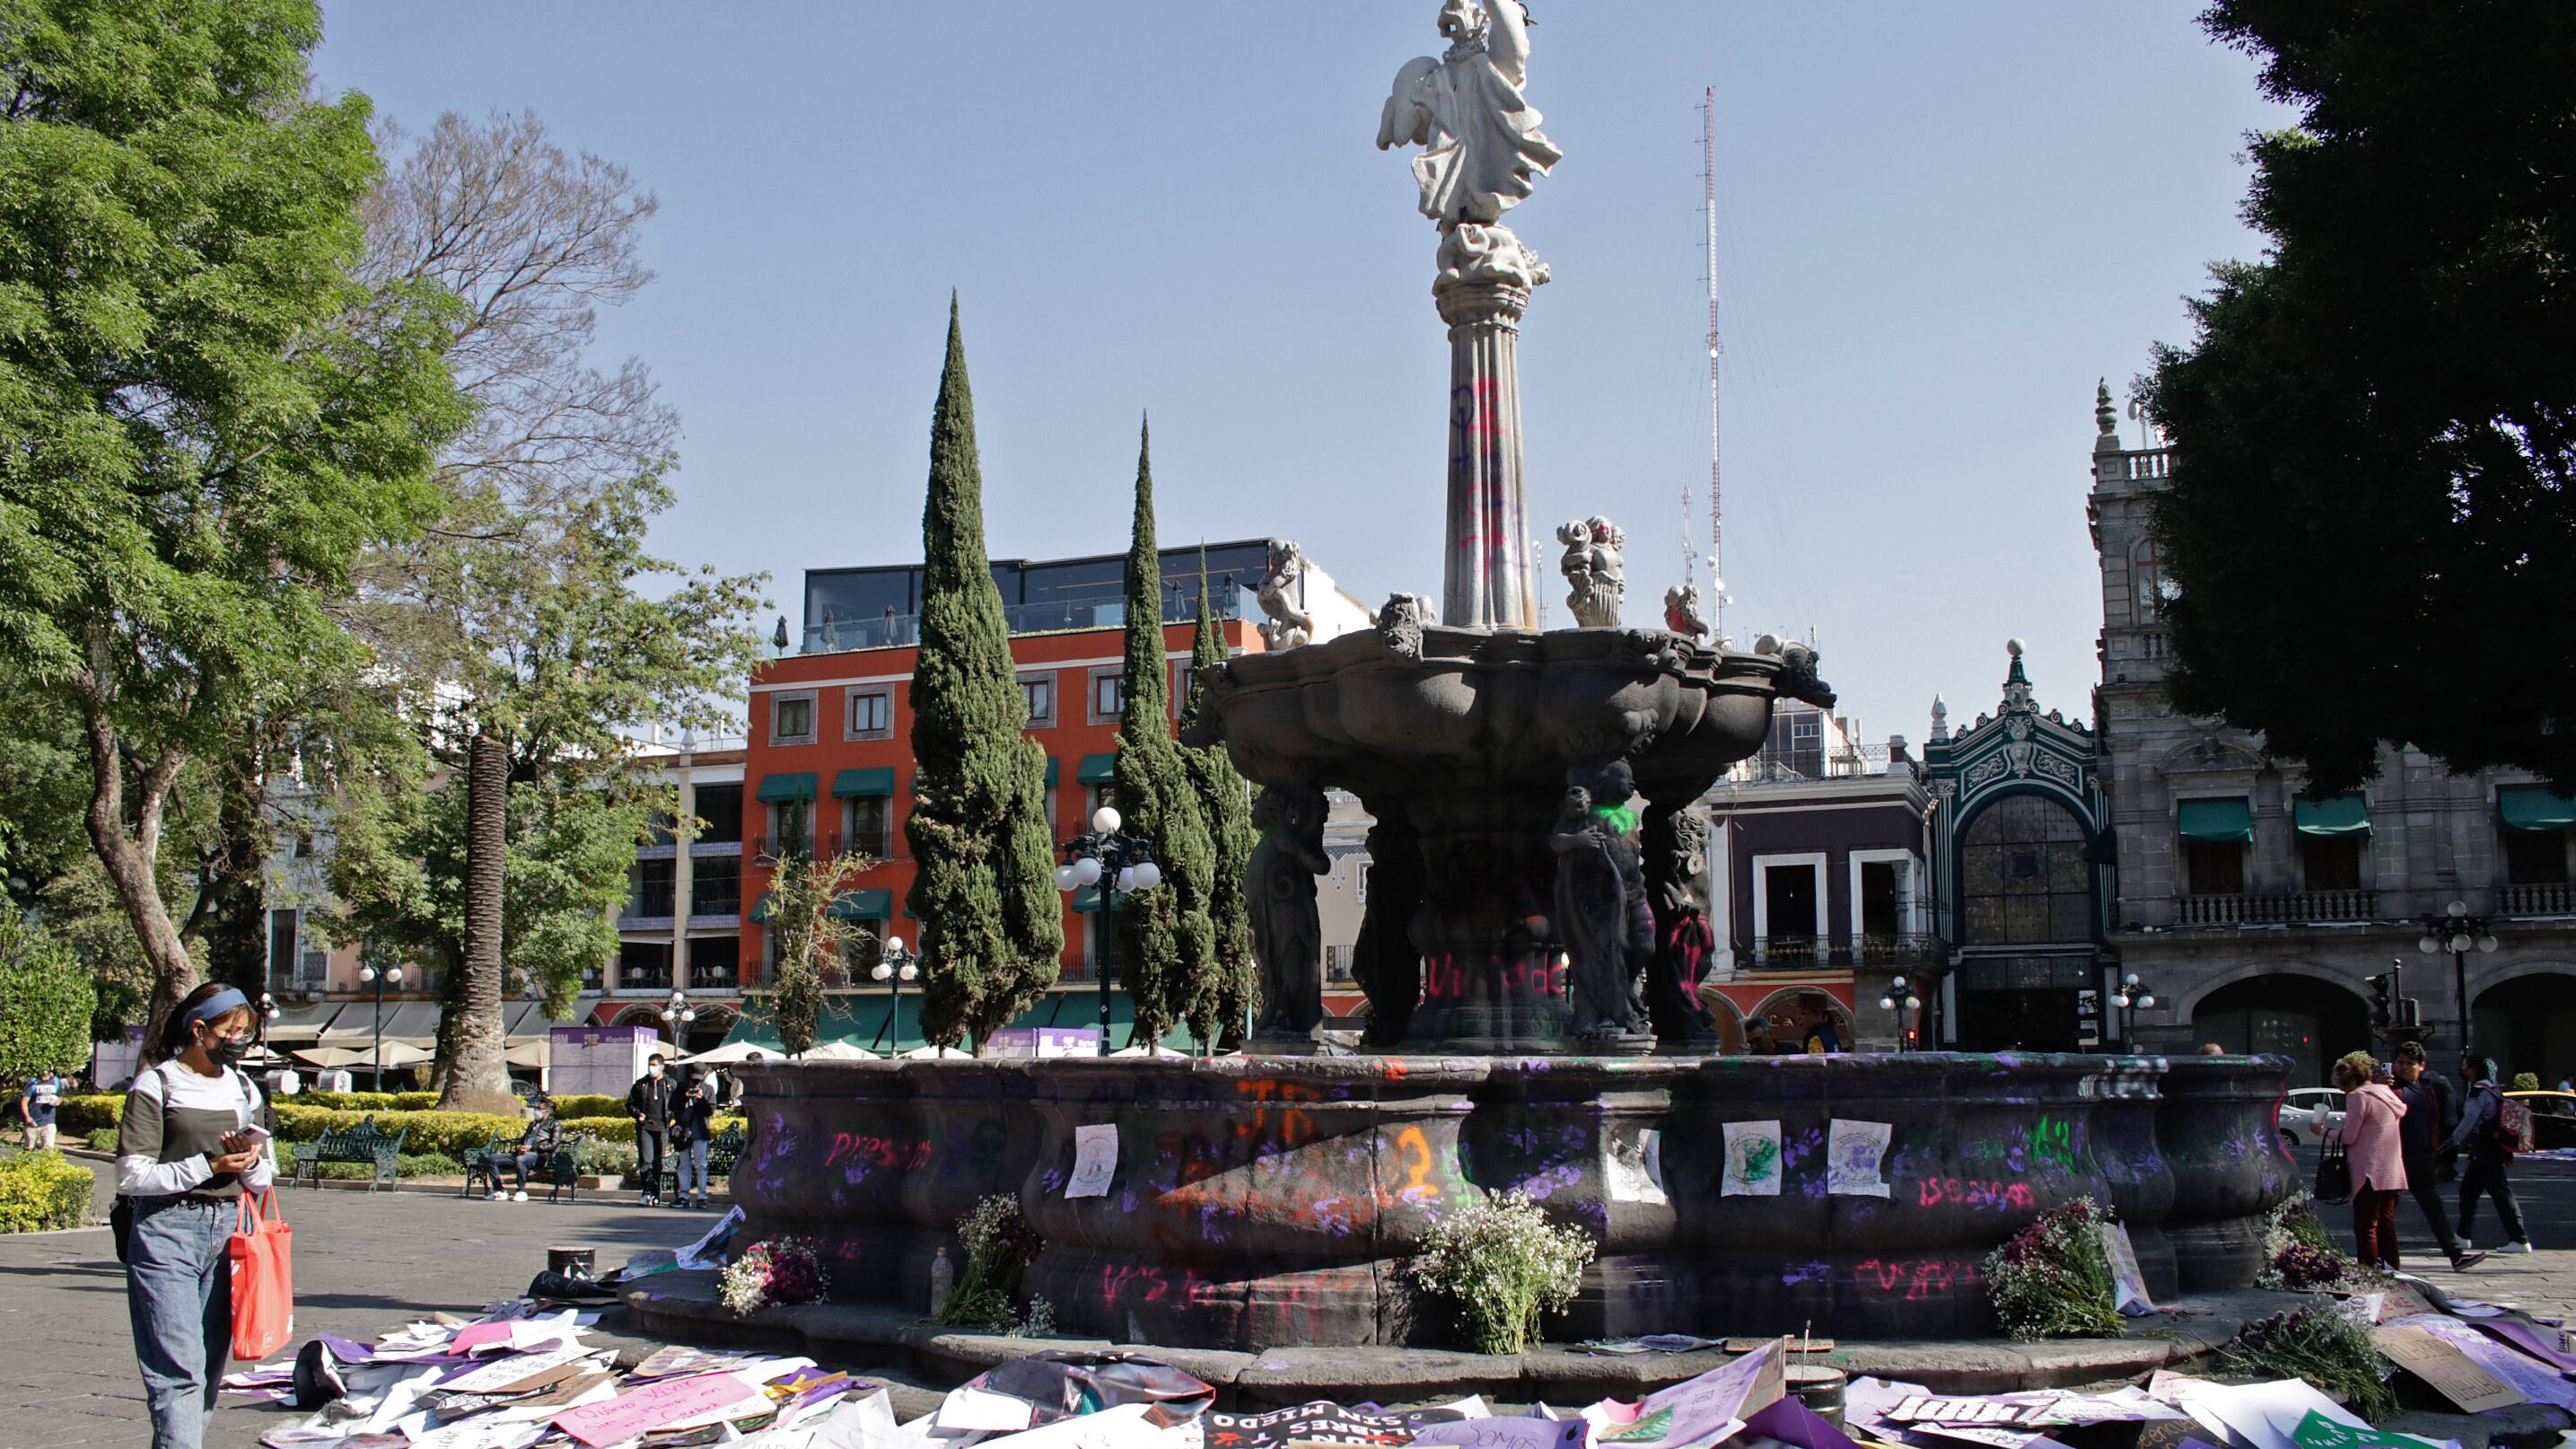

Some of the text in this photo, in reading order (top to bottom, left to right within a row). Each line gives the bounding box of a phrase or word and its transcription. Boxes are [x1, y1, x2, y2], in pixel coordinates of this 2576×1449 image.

[1213, 1403, 1403, 1427] SIN MIEDO
[1289, 1419, 1408, 1436] LIBRES
